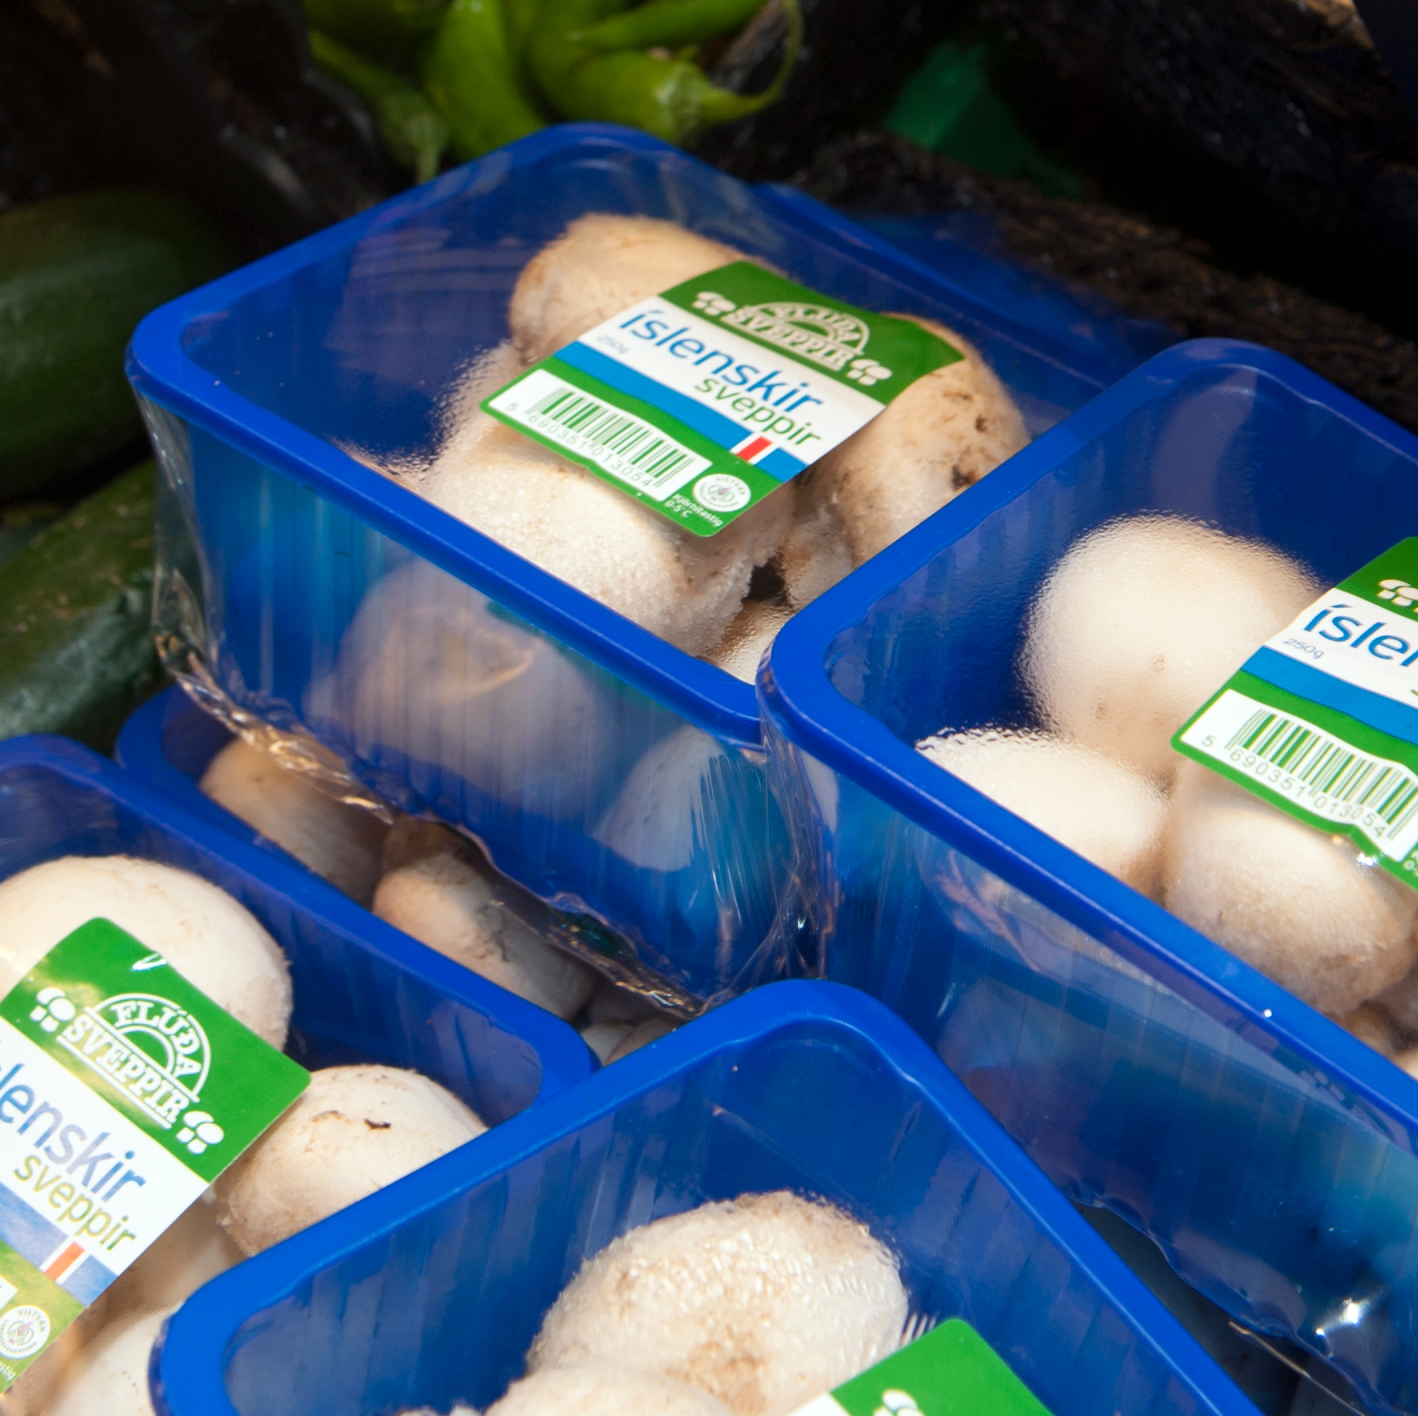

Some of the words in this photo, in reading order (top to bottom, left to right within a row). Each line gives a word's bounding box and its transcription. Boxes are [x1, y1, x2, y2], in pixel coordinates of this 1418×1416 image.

[618, 309, 824, 412] íslenskir
[694, 377, 821, 445] sveppir
[1283, 637, 1325, 659] 250g
[1229, 748, 1307, 798] 690351
[61, 1013, 190, 1124] SVEPPIR
[13, 1154, 136, 1251] sveppir
